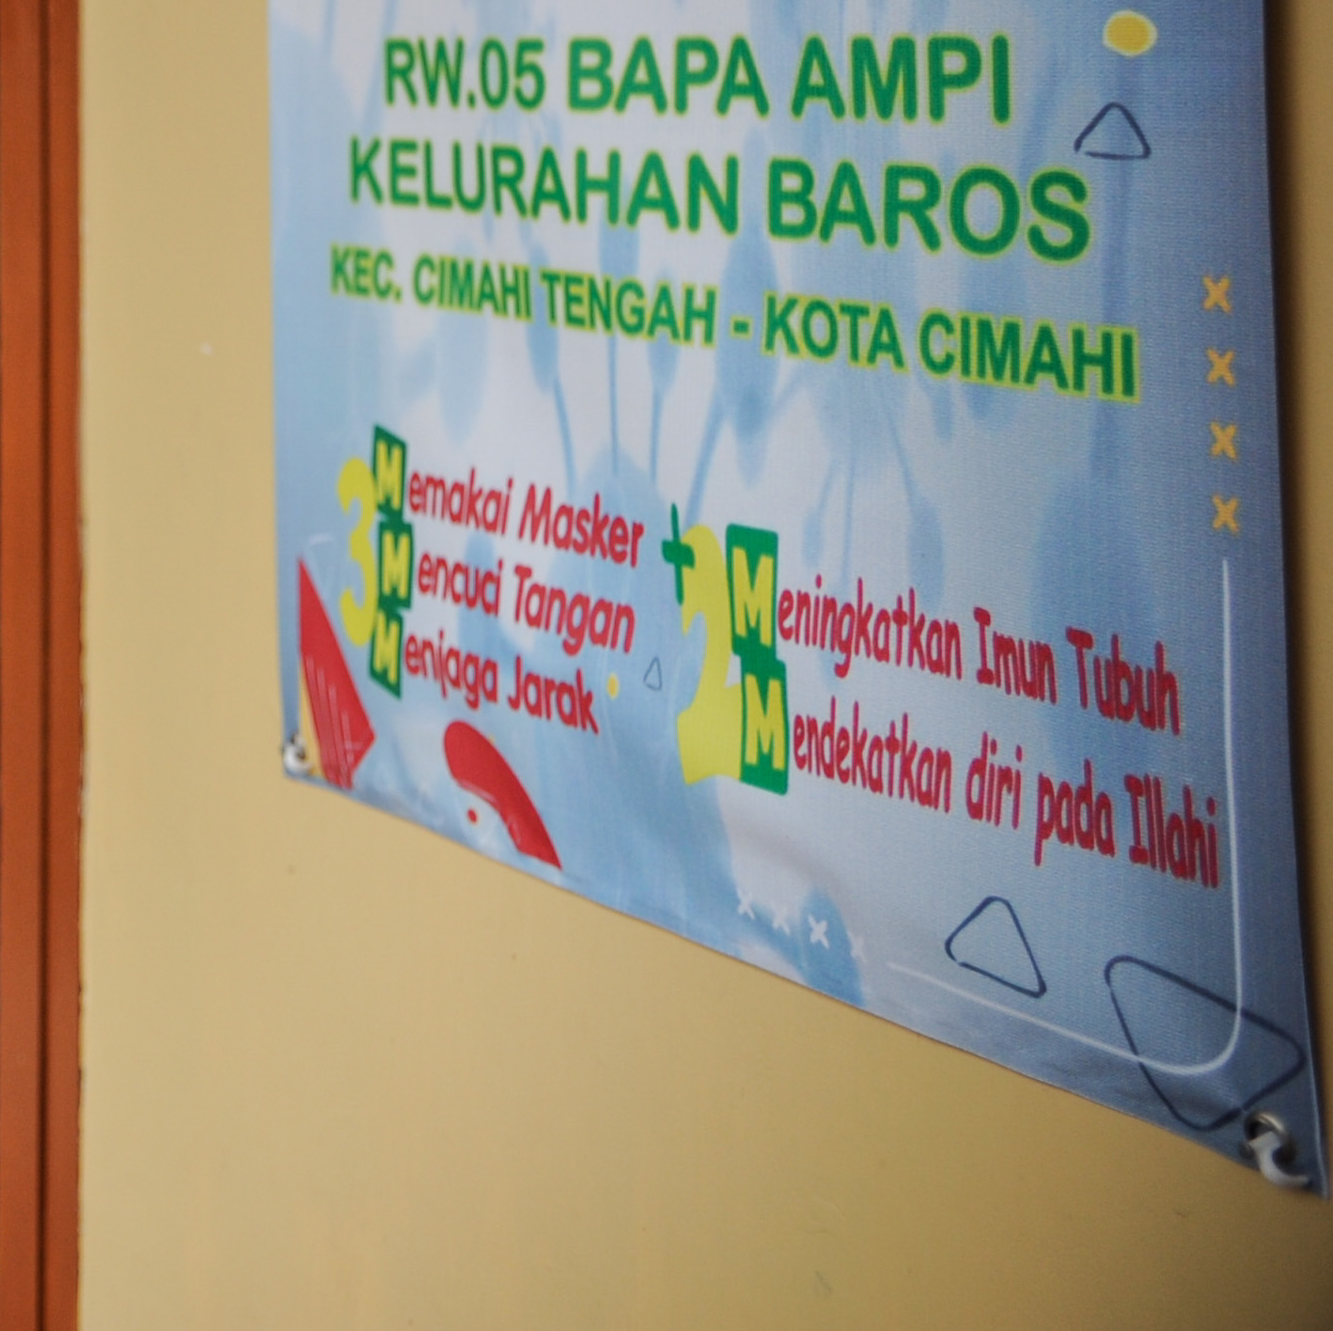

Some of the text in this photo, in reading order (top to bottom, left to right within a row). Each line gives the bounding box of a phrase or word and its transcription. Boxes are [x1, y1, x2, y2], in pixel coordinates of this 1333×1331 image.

[383, 33, 1012, 125] RW.05 BAPA AMPI
[349, 136, 1091, 264] KELURAHAN BAROS
[331, 242, 402, 302] KEC.
[413, 253, 533, 322] CIMAHI
[539, 268, 717, 346] TENGAH
[763, 291, 907, 370] KOTA
[918, 308, 1140, 403] CIMAHI
[337, 457, 378, 647] 3
[376, 439, 644, 568] Memakai Masker
[373, 610, 599, 735] Menjaga Jarak
[513, 564, 636, 656] Tangan
[676, 524, 742, 784] 2
[733, 546, 1181, 735] Meningkatkan Imun Tubuh
[744, 673, 1220, 889] Mendekatkan diri pada Illahi
